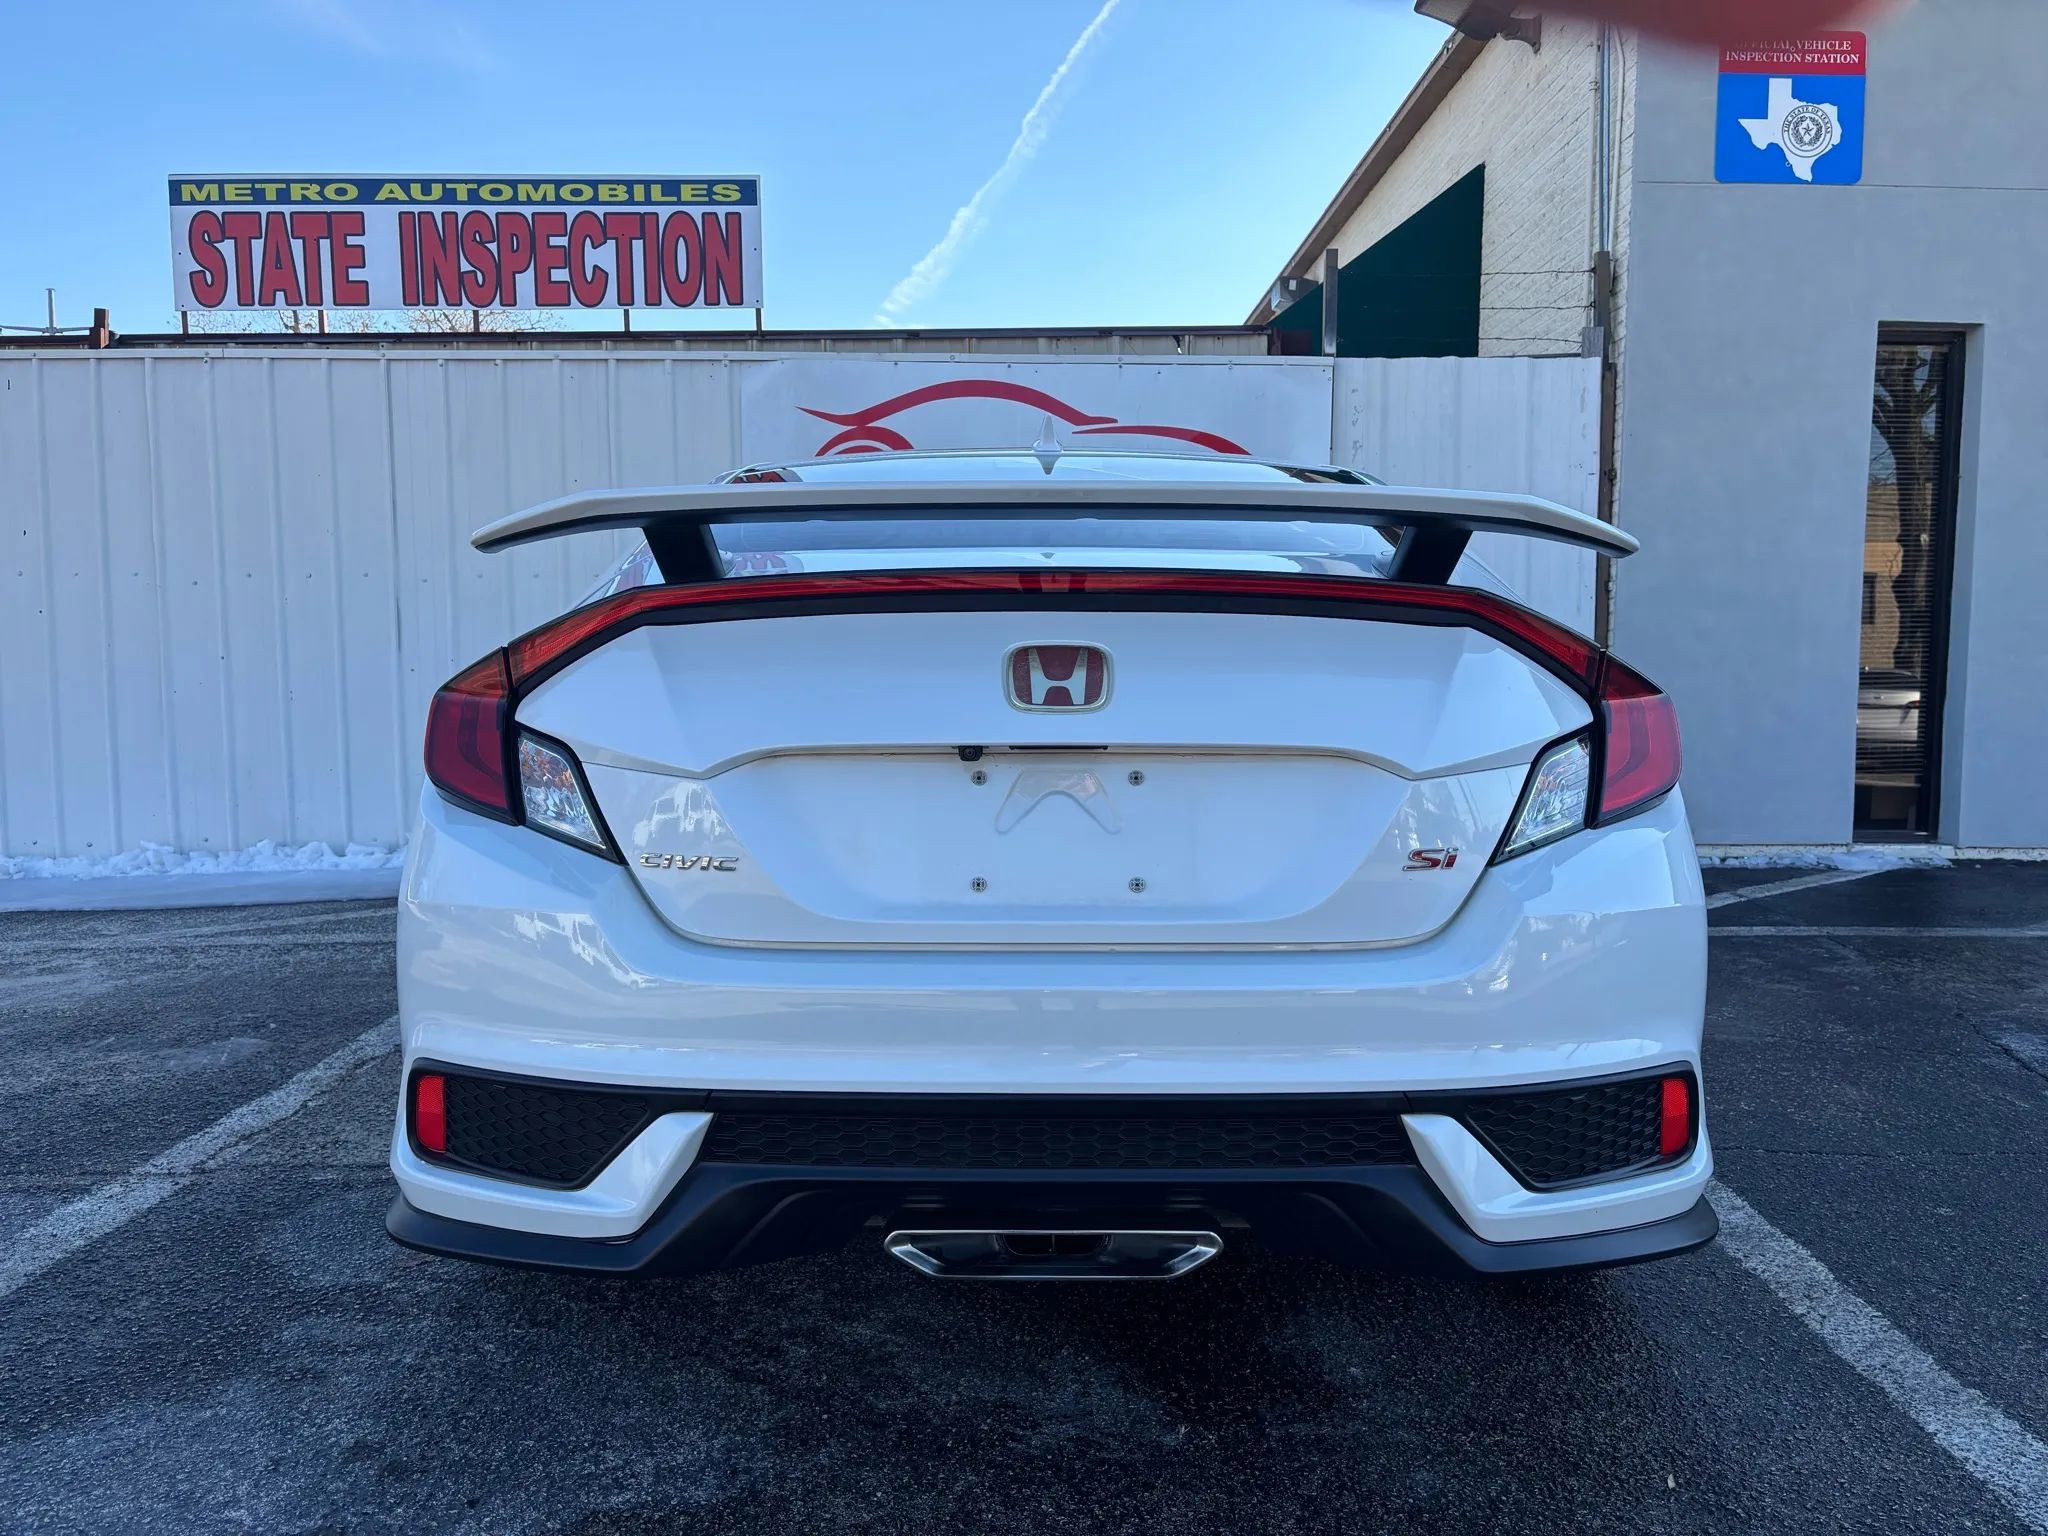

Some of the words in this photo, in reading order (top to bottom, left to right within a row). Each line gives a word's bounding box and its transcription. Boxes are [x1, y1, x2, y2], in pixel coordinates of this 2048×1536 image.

[1736, 40, 1790, 49] ICIAL
[1796, 40, 1851, 50] VEHICLE
[1726, 51, 1802, 63] INSPECTION
[1804, 54, 1860, 64] STATION
[1790, 106, 1810, 119] STATE
[1811, 107, 1820, 115] OF
[1820, 112, 1831, 134] TEXAS
[181, 182, 359, 202] METRO
[375, 182, 742, 202] AUTOMOBILES
[188, 209, 369, 307] STATE
[398, 209, 743, 307] INSPECTION
[640, 852, 739, 872] CIVIC
[1401, 847, 1459, 871] Si
